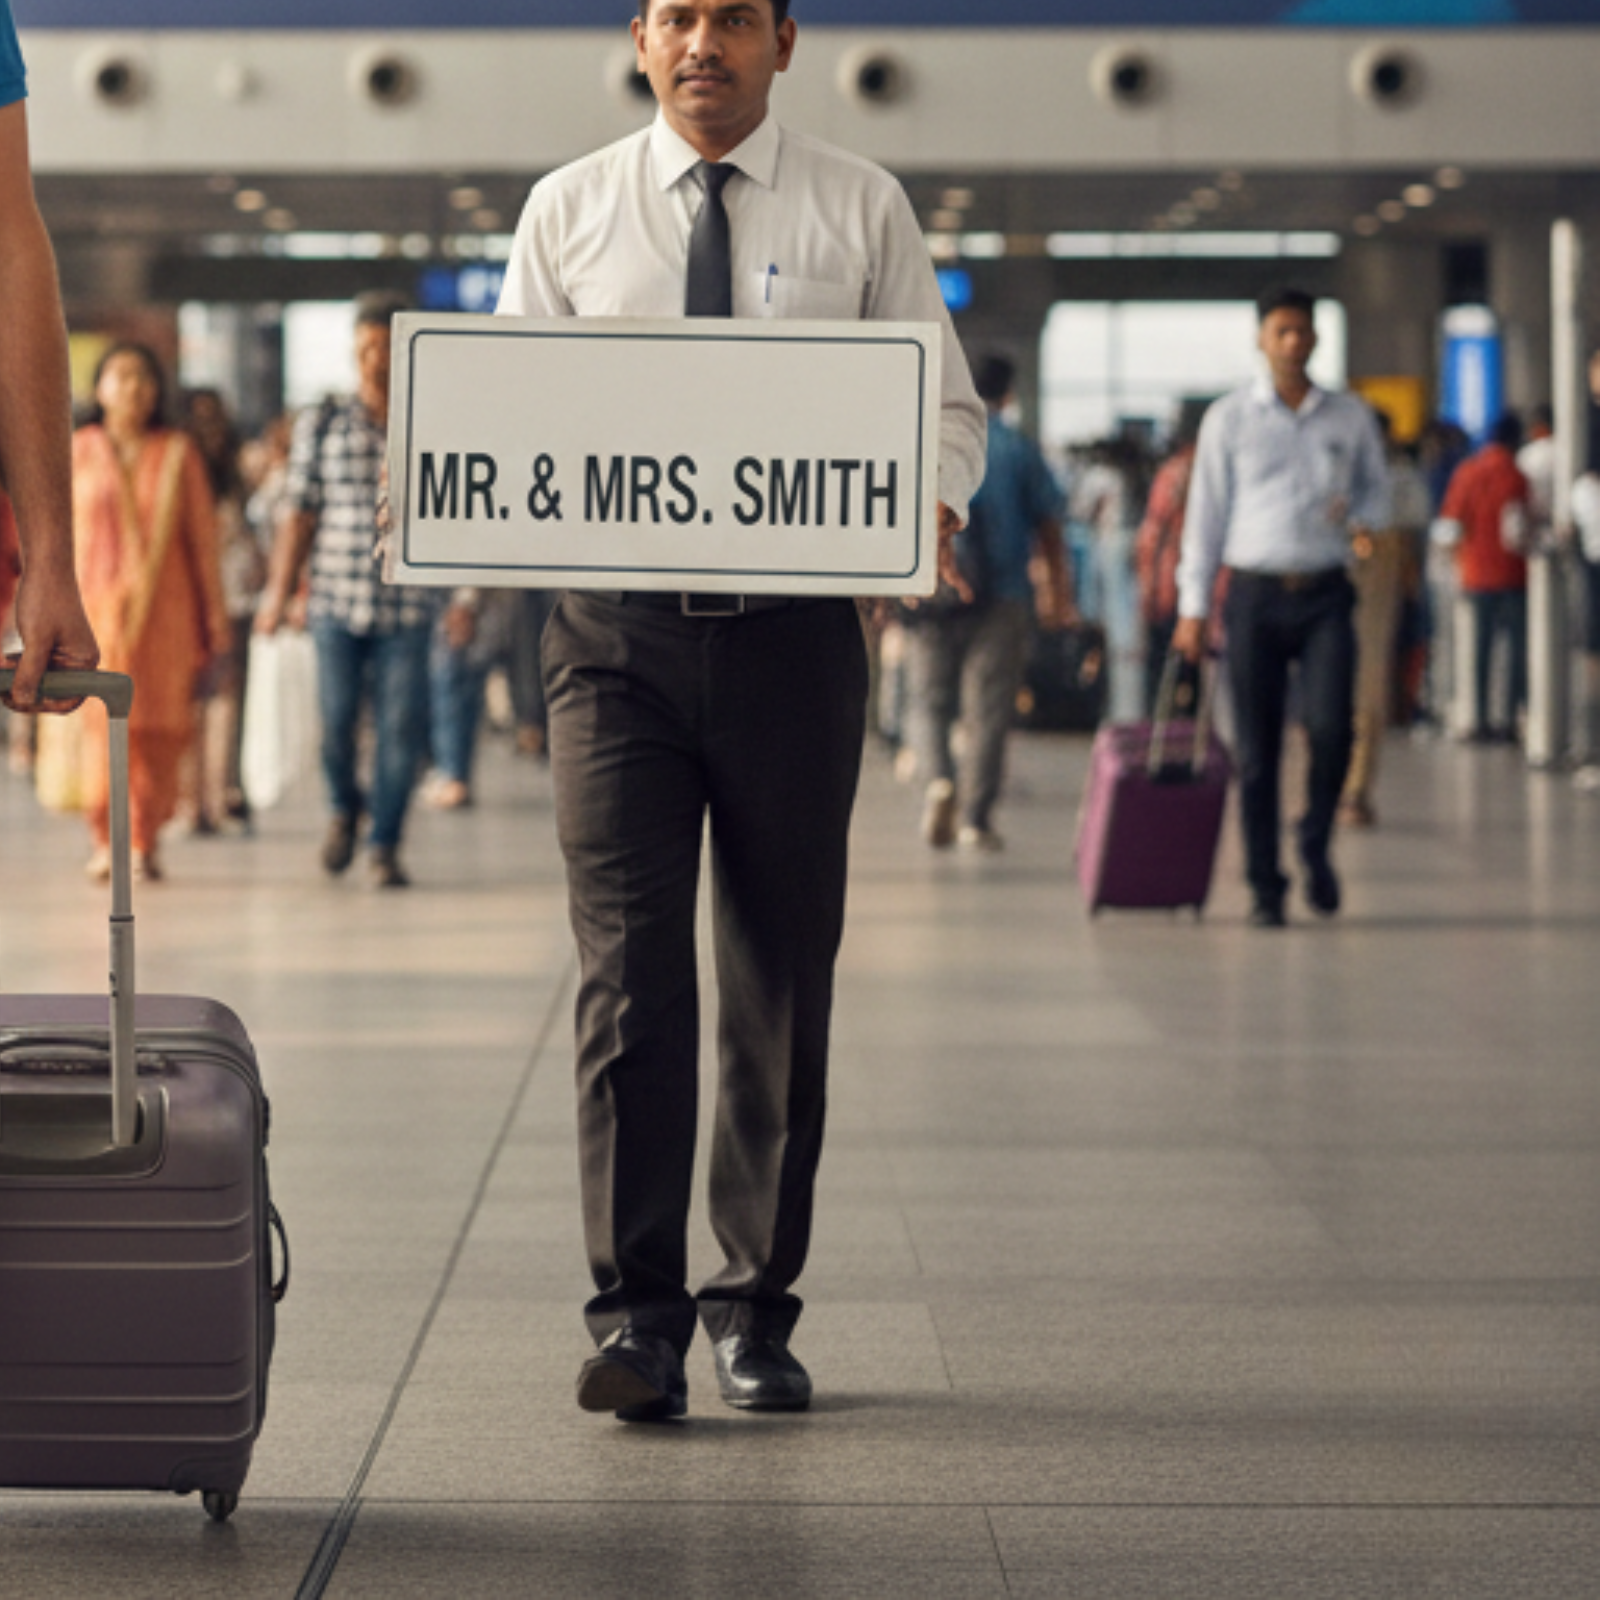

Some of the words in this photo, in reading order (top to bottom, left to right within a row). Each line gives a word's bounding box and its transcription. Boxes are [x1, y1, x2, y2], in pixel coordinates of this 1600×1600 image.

[418, 452, 509, 520] MR.
[527, 453, 563, 520] &
[584, 455, 712, 525] MRS.
[733, 456, 898, 528] SMITH
